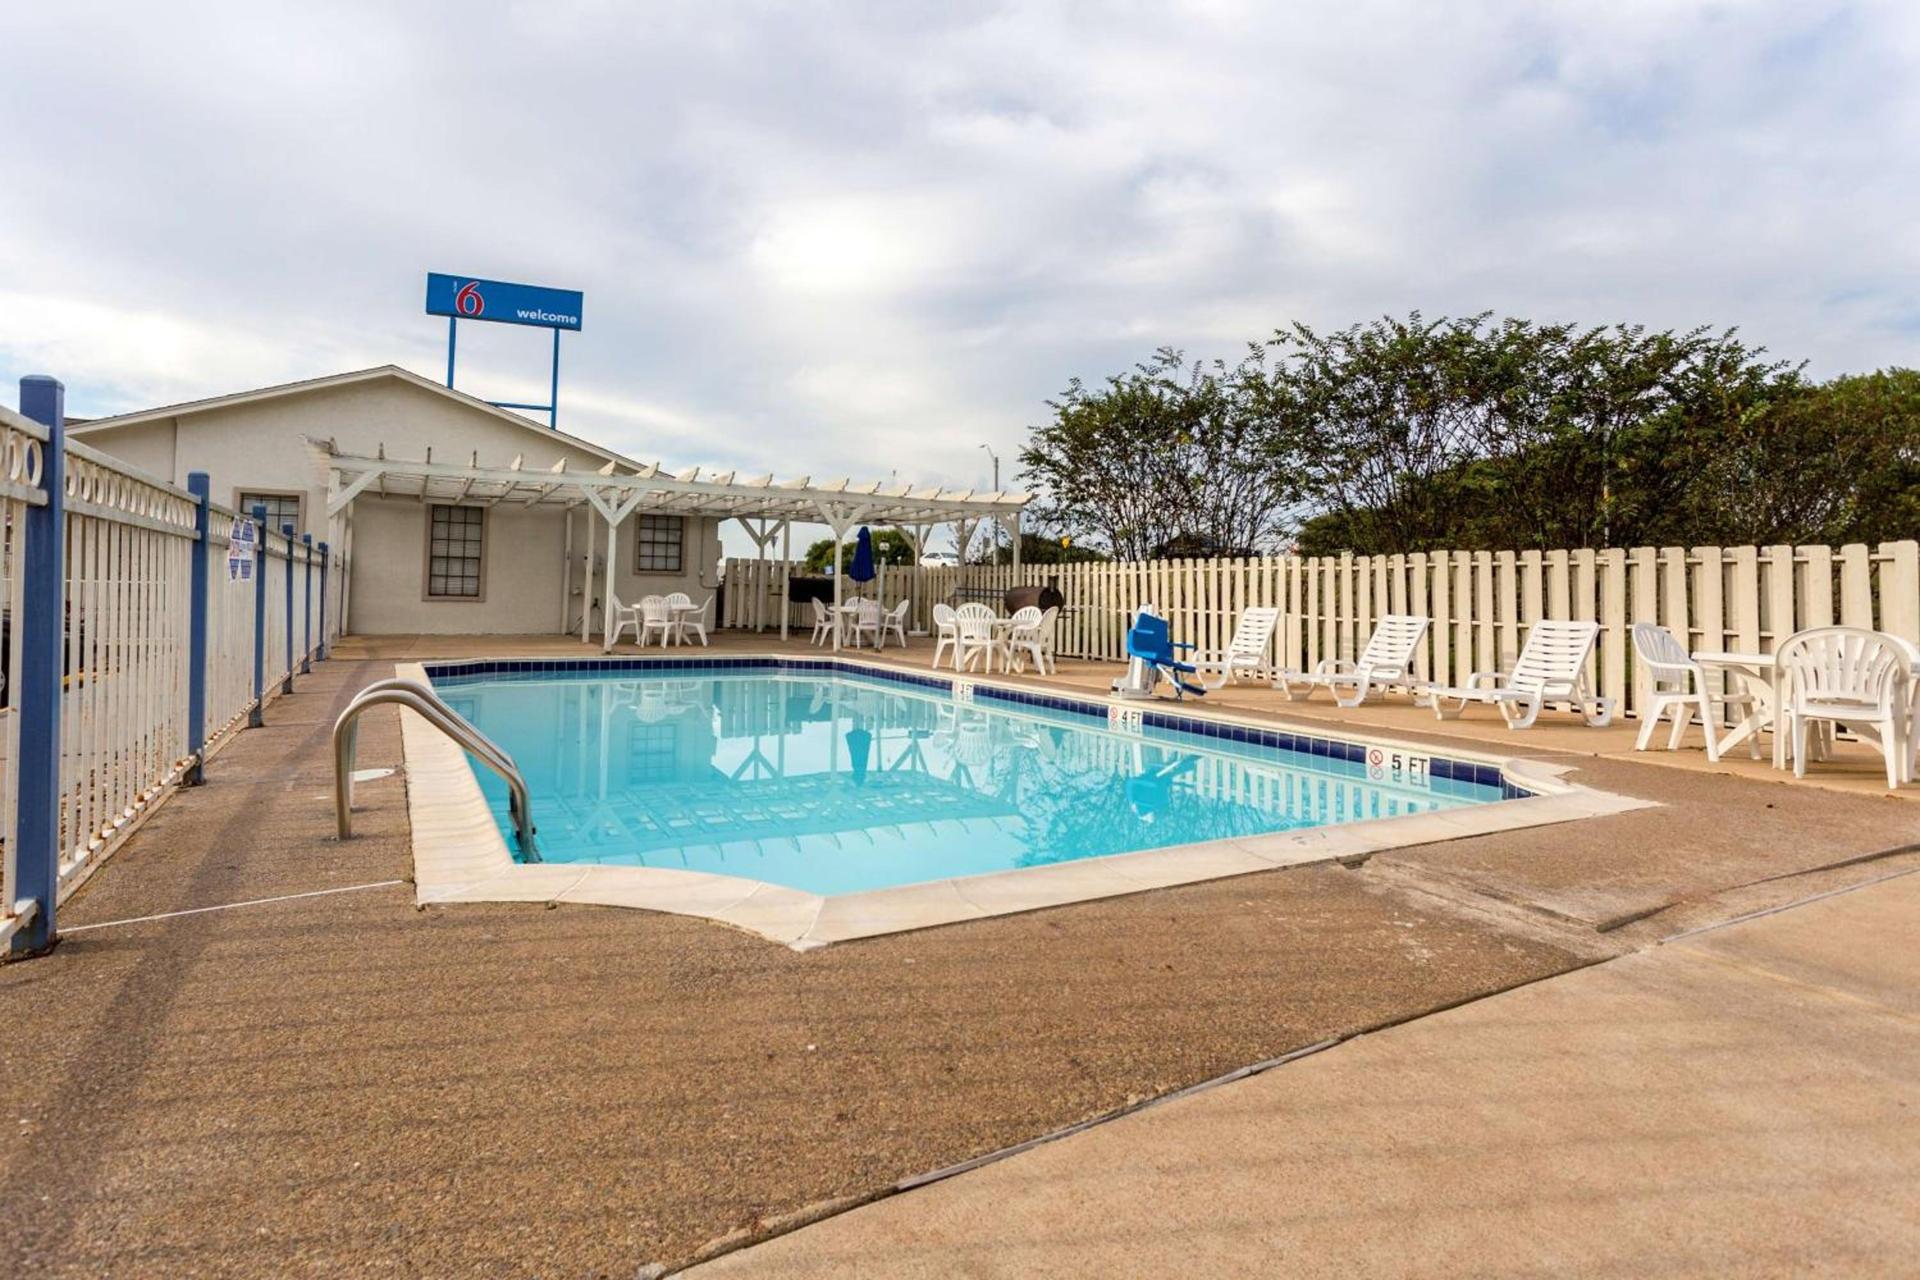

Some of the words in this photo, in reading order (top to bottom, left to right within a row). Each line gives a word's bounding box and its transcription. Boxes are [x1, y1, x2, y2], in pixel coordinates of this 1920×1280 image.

[456, 281, 485, 315] 6
[516, 309, 577, 324] welcome
[1122, 710, 1127, 721] 4
[1131, 711, 1141, 723] FT
[1391, 754, 1402, 770] 5
[1409, 757, 1427, 774] FT
